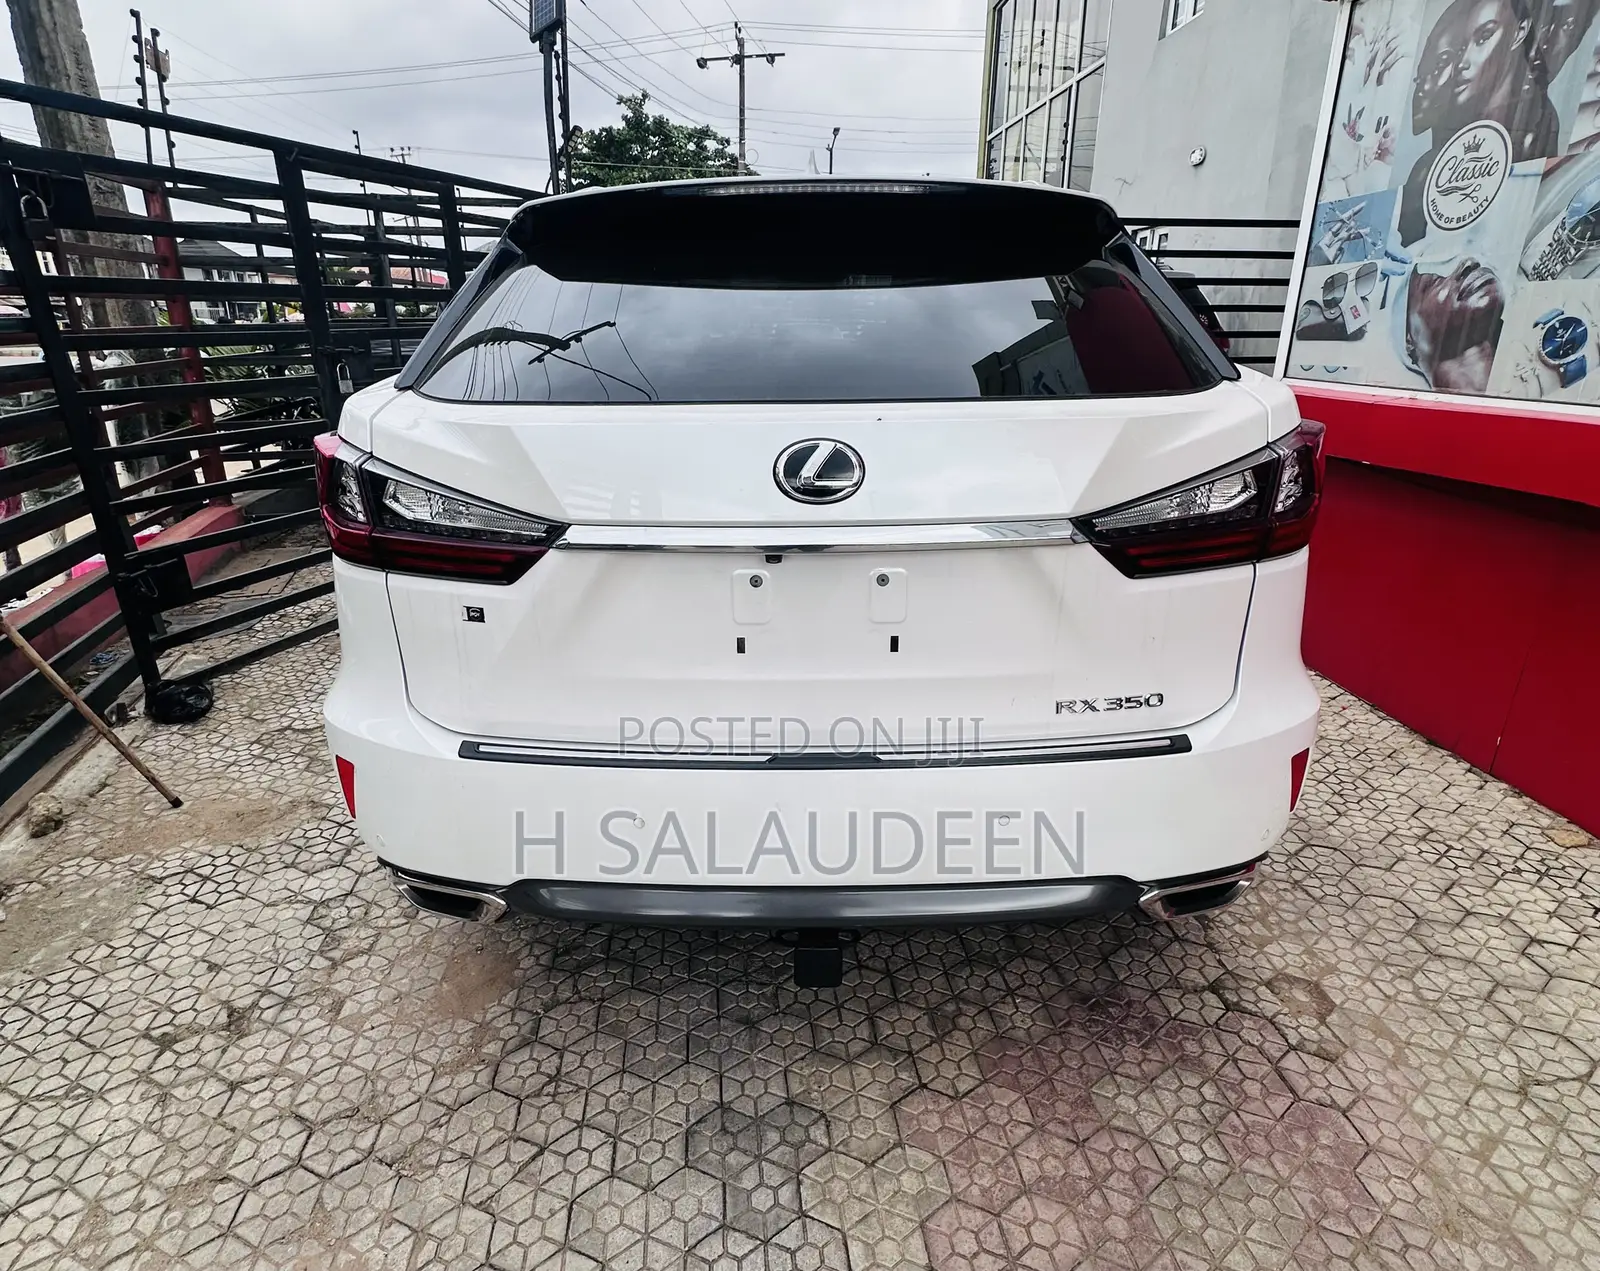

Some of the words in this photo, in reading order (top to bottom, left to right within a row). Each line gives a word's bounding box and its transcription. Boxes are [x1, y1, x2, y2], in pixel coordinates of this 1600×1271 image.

[1435, 155, 1500, 189] Classic
[1430, 197, 1445, 221] HOME
[1444, 215, 1455, 224] OF
[1456, 195, 1490, 224] BEAUTY
